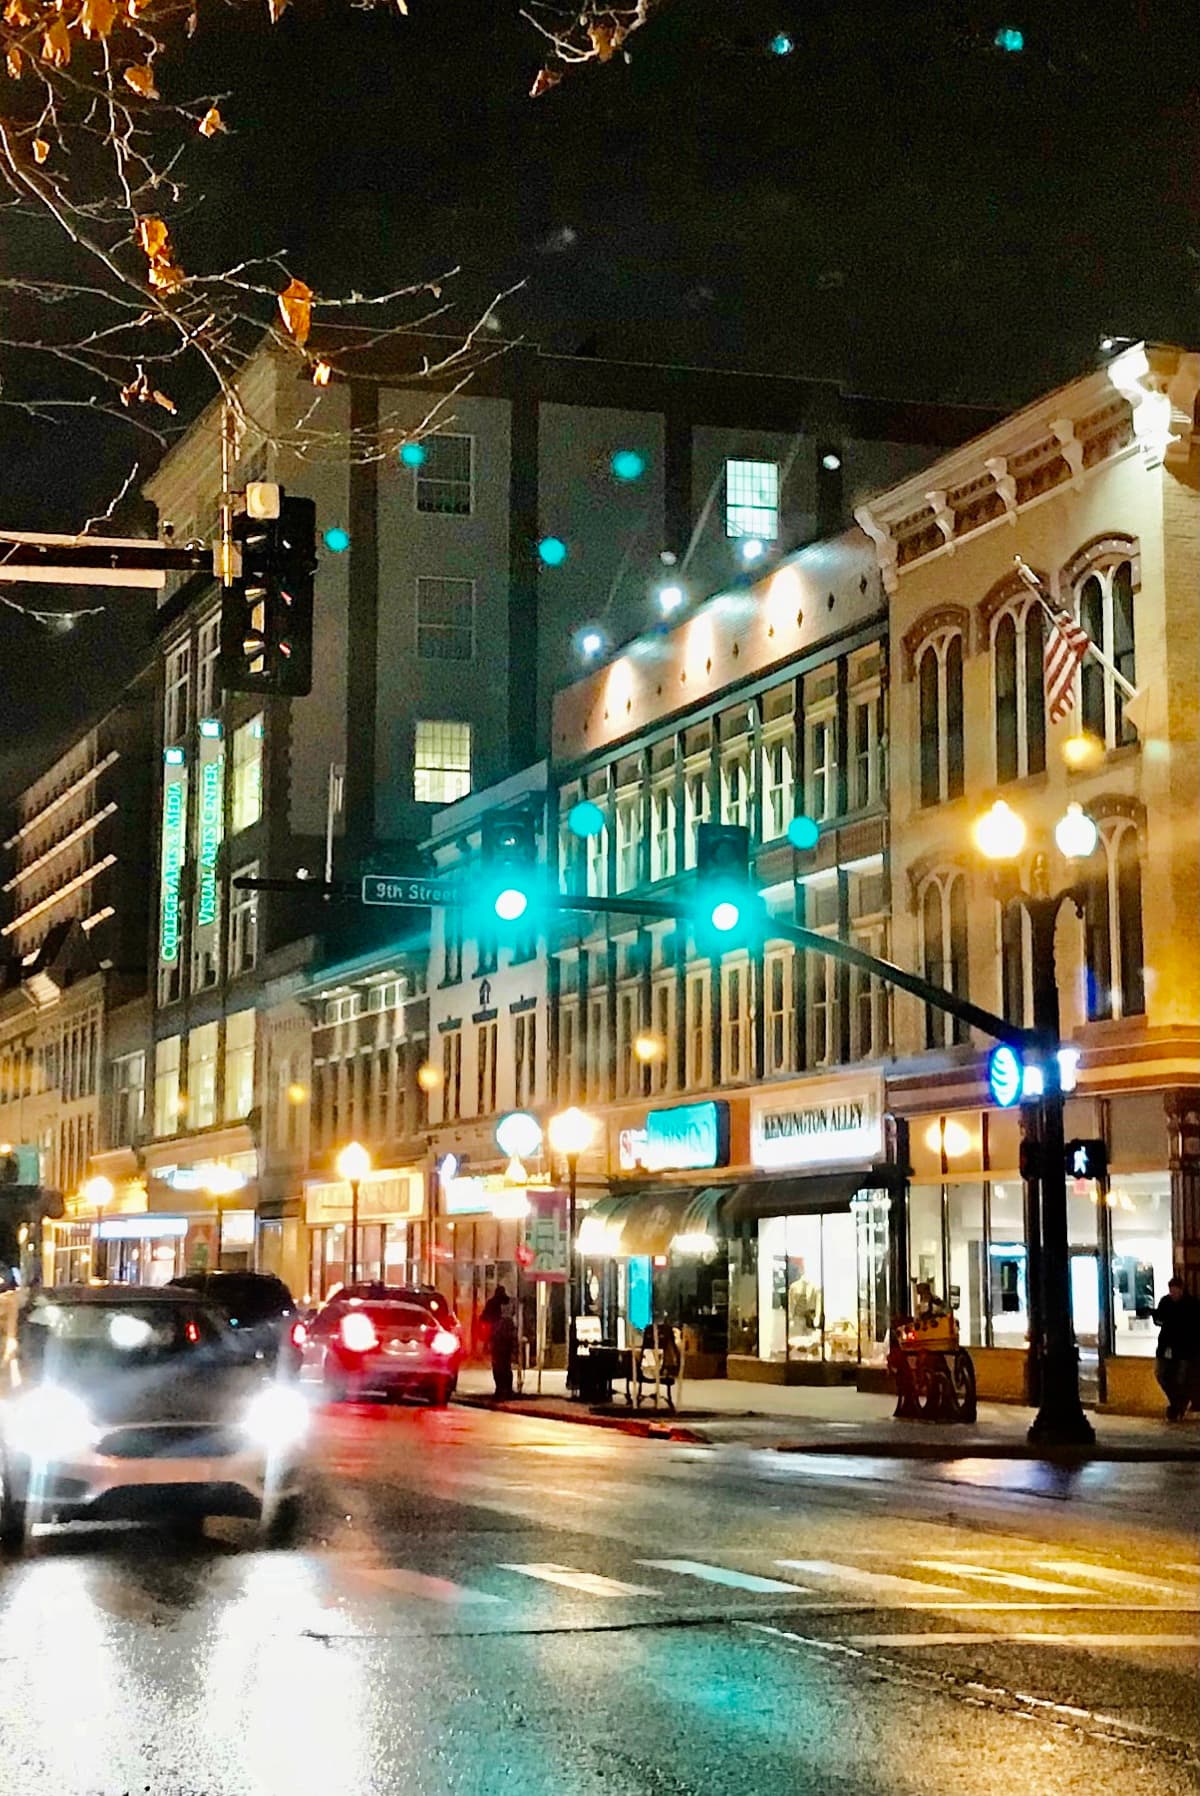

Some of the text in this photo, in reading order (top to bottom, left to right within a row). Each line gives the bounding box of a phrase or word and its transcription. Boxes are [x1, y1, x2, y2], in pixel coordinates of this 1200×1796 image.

[166, 781, 182, 830] MEDIA
[198, 763, 219, 926] VISUAL ARTS CENTER
[165, 847, 180, 887] ARTS
[376, 882, 457, 901] 9th Street
[161, 895, 179, 961] COLLEGE
[831, 1103, 863, 1132] ALLEY
